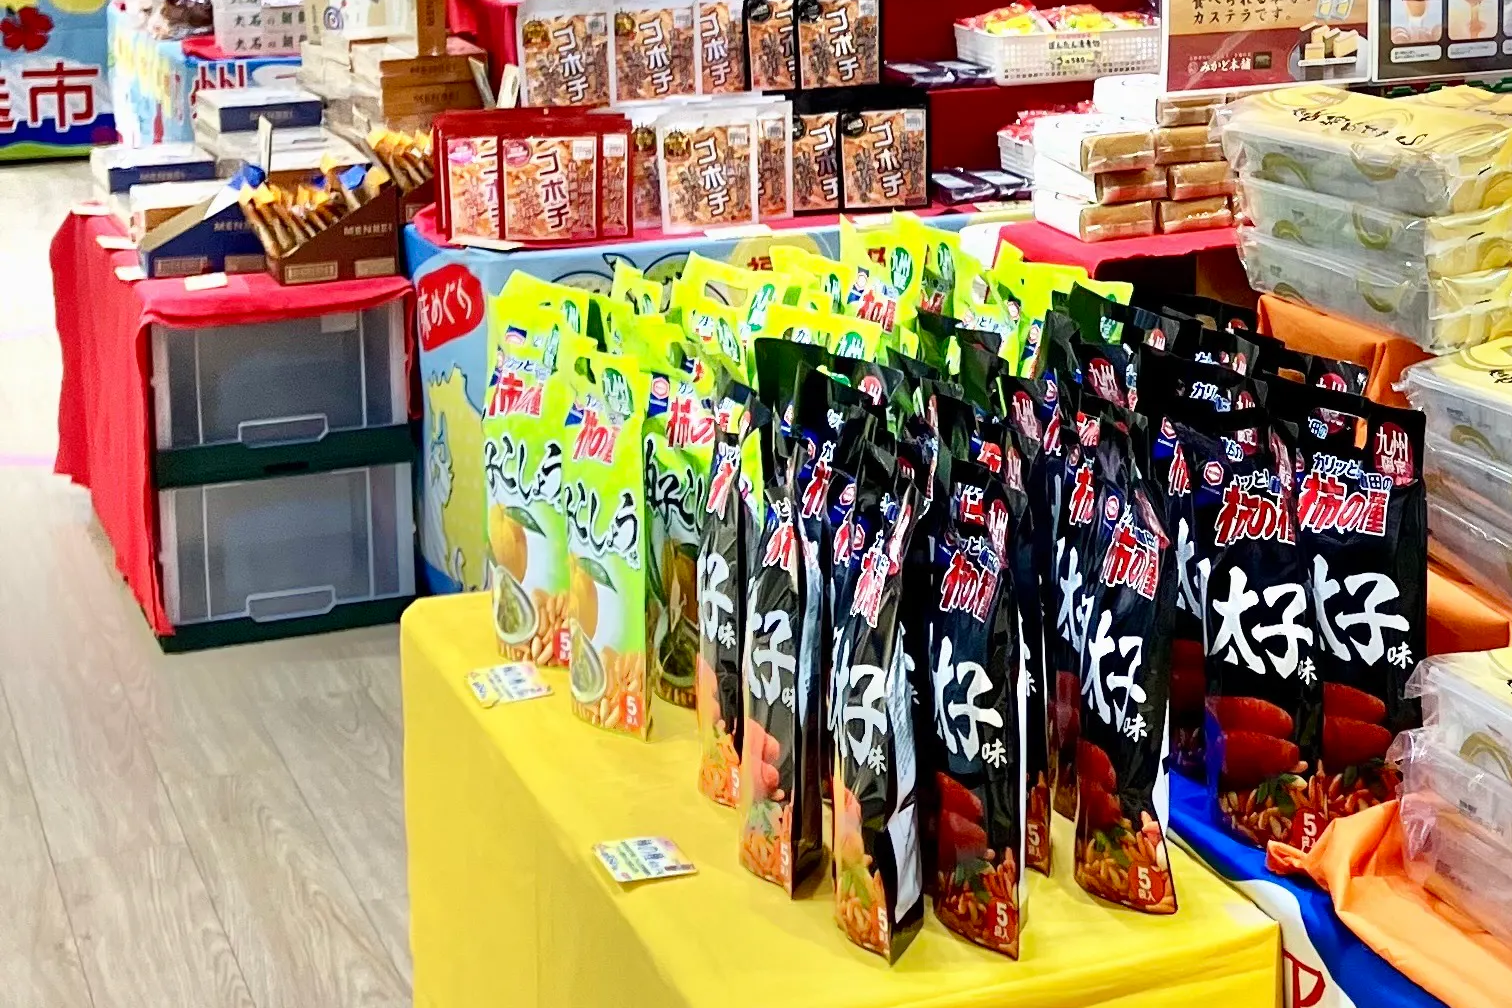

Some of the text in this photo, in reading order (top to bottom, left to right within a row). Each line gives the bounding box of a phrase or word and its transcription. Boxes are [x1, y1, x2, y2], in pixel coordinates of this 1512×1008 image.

[1376, 425, 1409, 460] 九州
[1299, 470, 1390, 537] 柿の種
